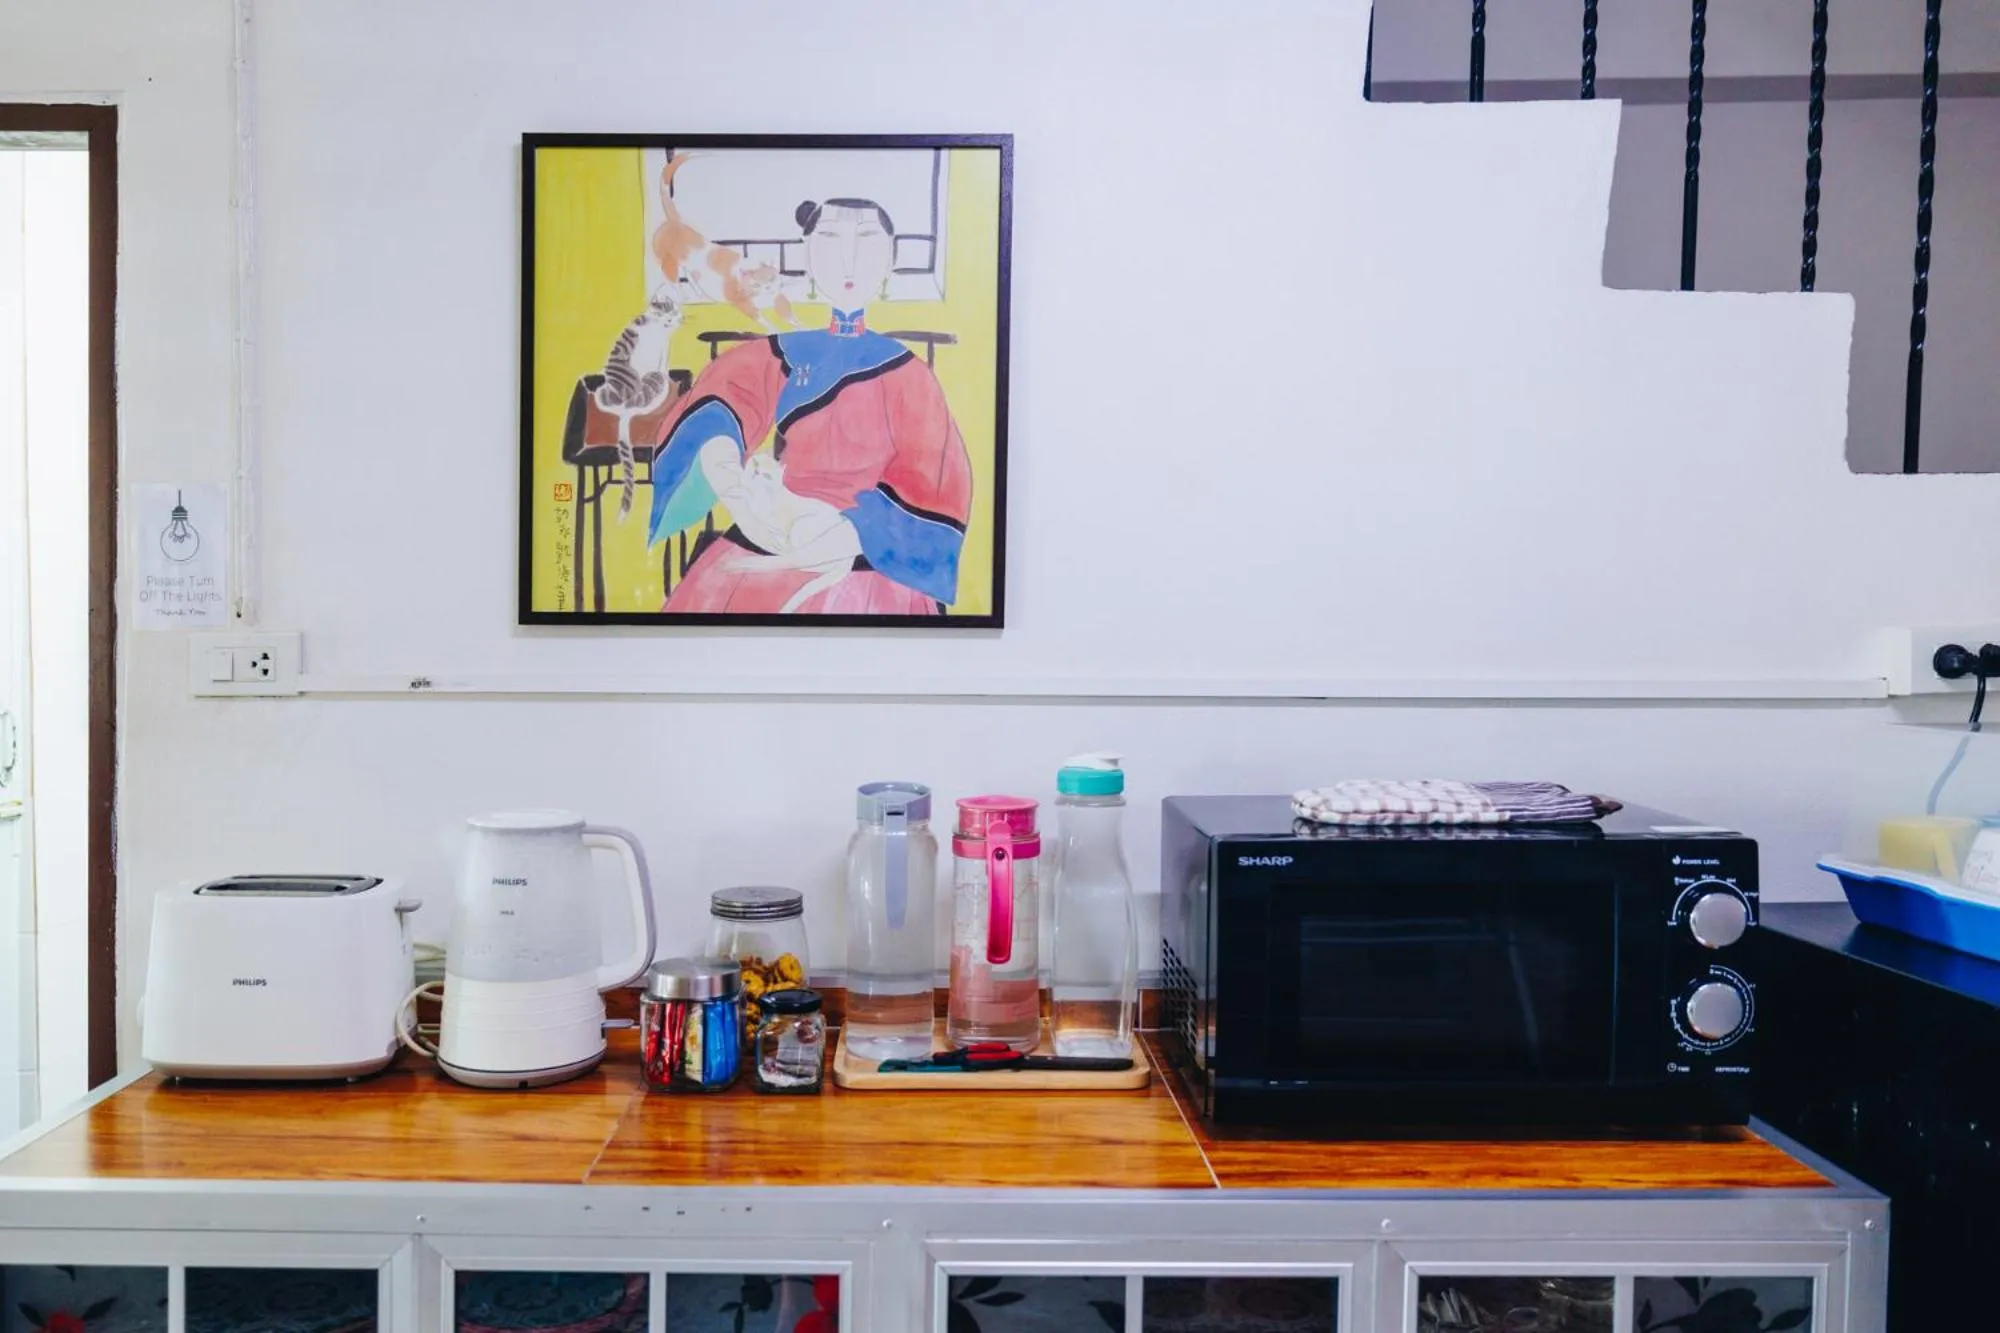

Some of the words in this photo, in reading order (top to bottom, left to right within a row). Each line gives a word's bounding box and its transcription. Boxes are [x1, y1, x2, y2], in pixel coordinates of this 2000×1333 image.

[1237, 856, 1294, 866] SHARP
[492, 878, 528, 886] PHILIPS
[232, 978, 267, 986] PHILIPS
